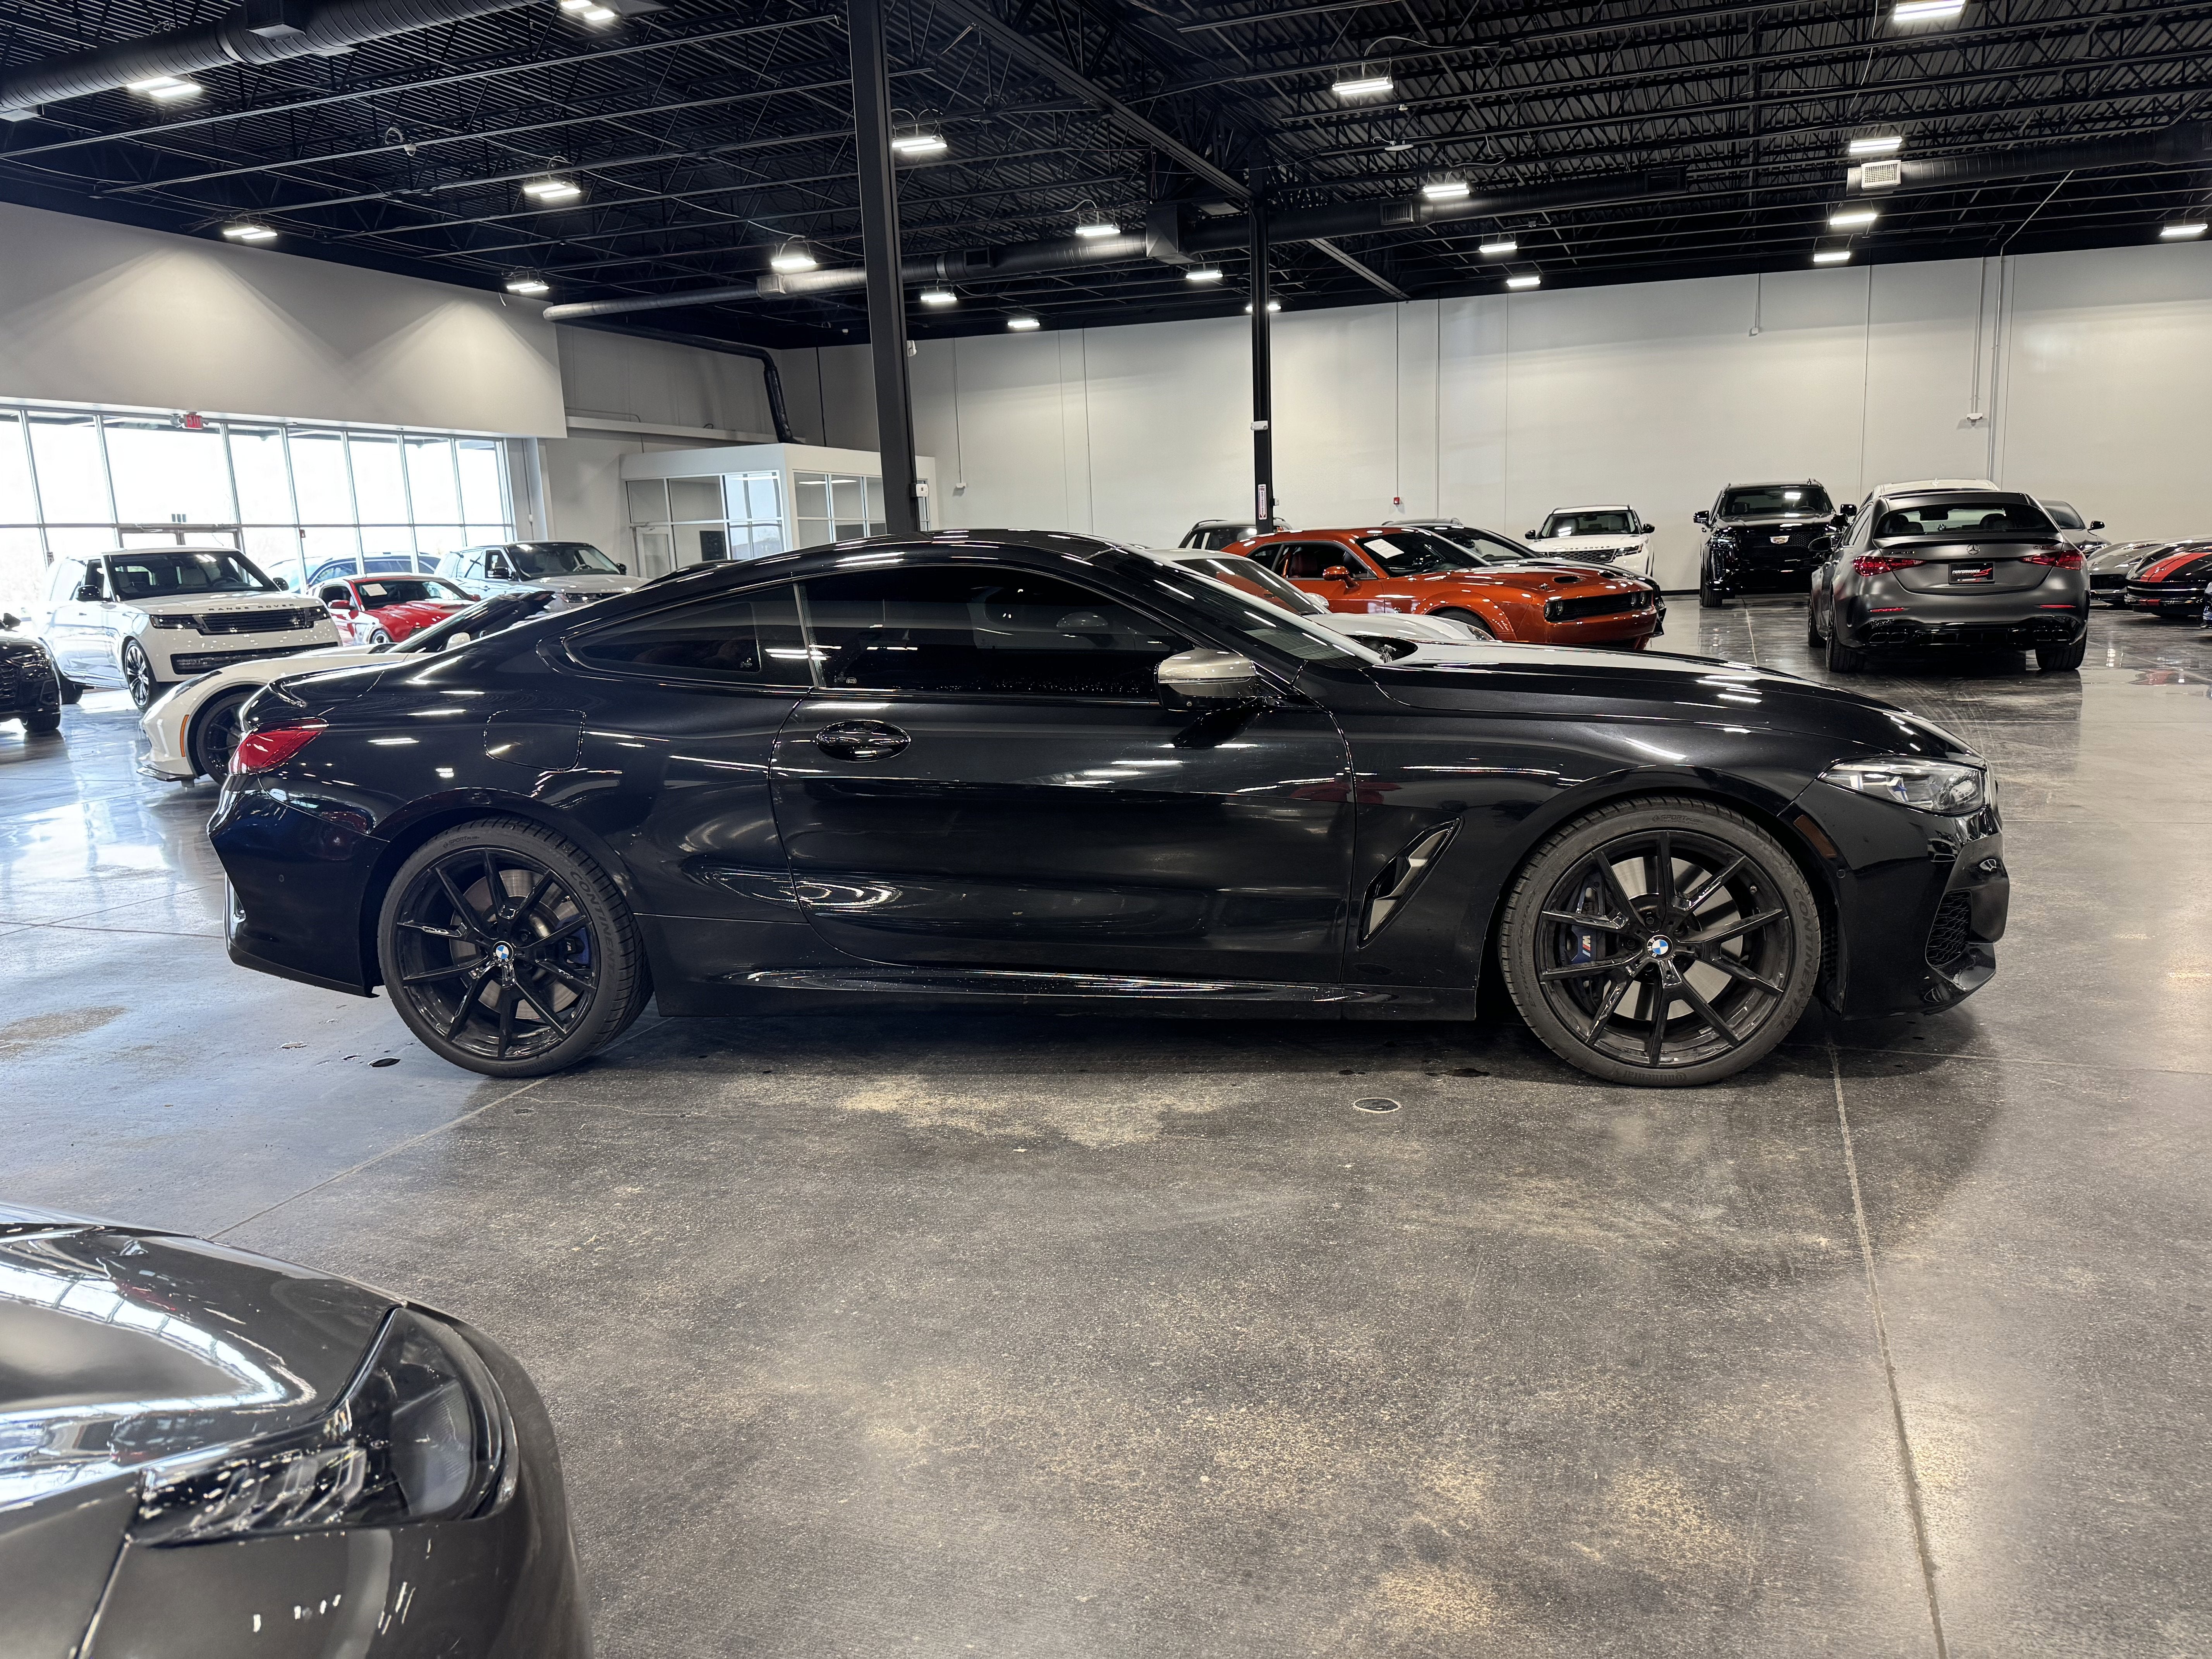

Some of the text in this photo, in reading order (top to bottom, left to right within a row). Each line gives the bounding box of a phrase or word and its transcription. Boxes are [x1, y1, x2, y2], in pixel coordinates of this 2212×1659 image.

[187, 414, 201, 428] EXIT
[1647, 938, 1657, 958] BMW
[493, 952, 509, 962] BMW
[1777, 888, 1813, 1029] CONTINENTAL
